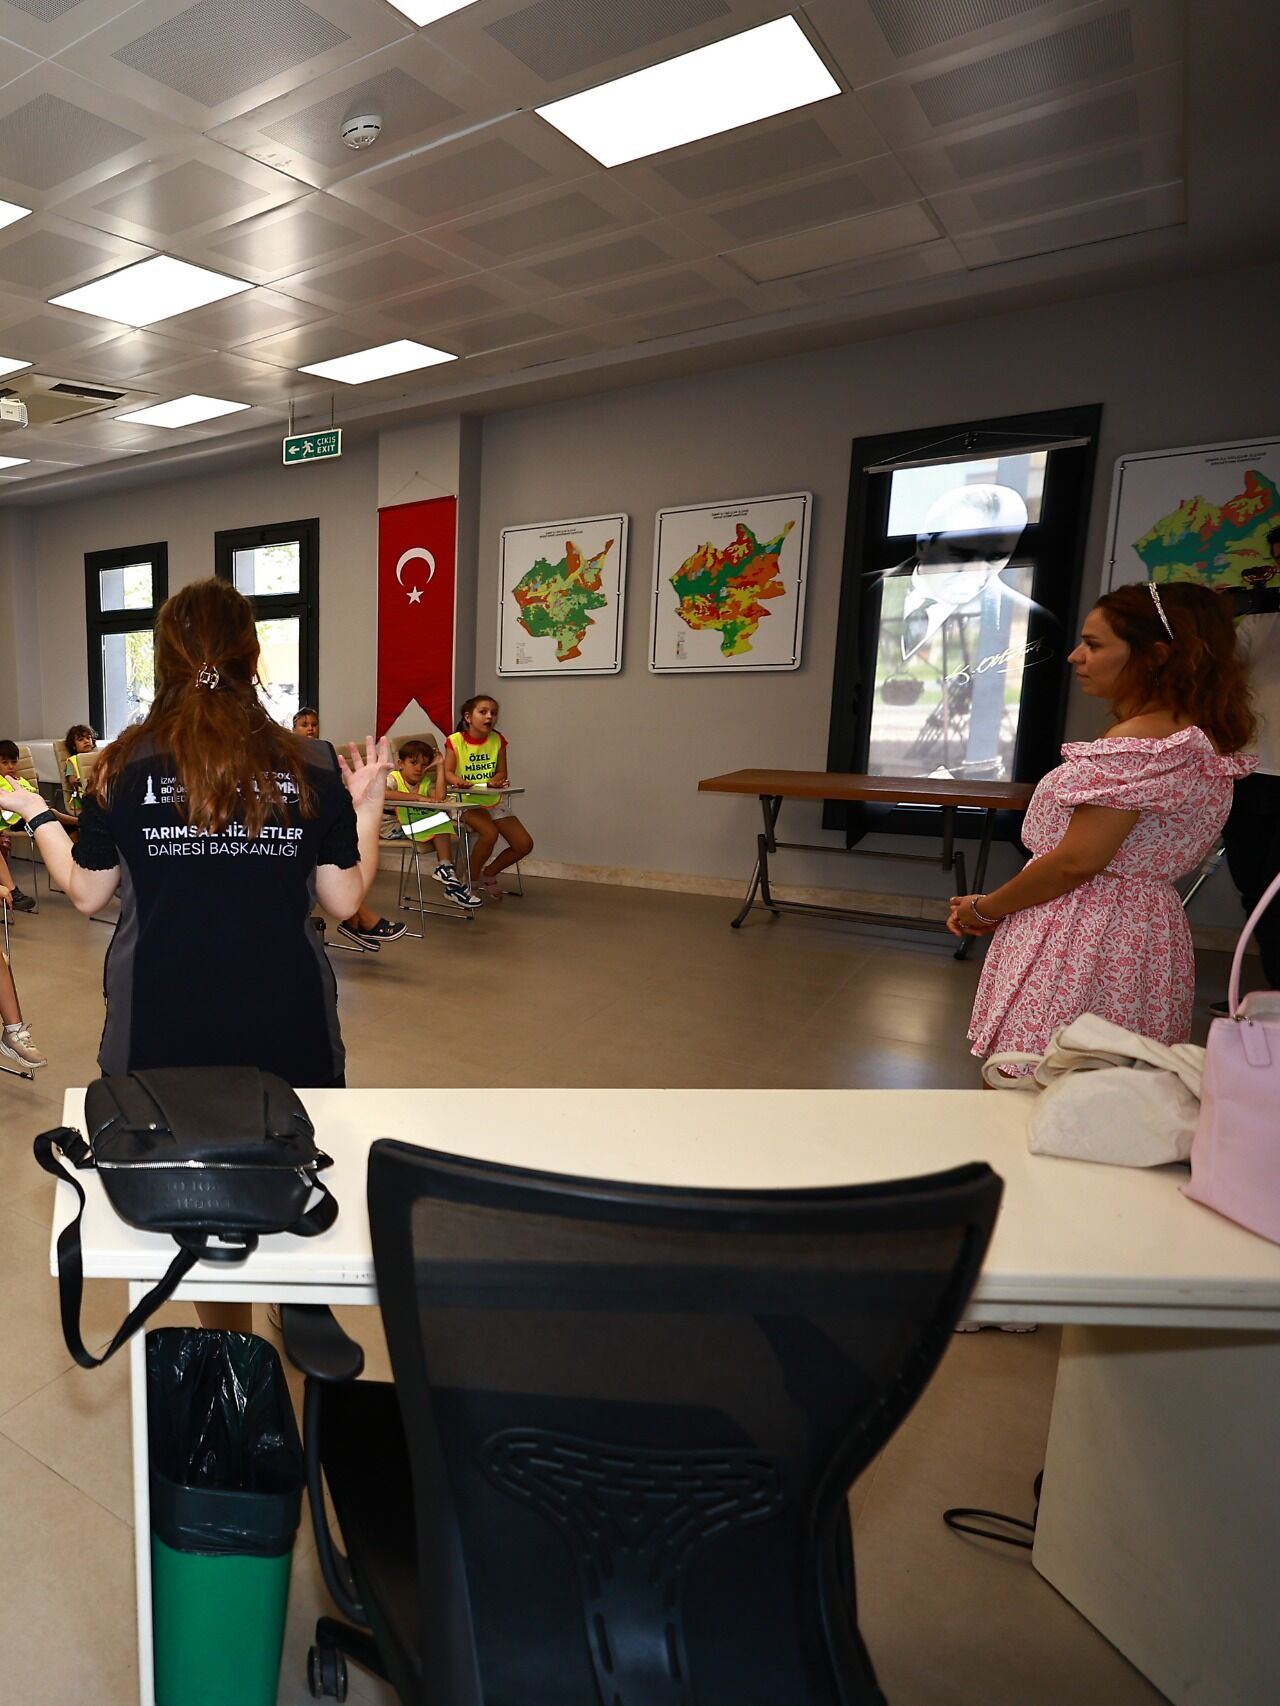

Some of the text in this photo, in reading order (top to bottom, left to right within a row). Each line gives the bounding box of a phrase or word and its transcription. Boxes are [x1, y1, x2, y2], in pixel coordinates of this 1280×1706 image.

[317, 445, 336, 454] EXIT
[469, 753, 490, 762] ÖZEL
[465, 762, 496, 771] MİSKET
[222, 821, 303, 840] HİZETLER
[148, 840, 298, 857] DAİRESİ BAŞKANLIĞI
